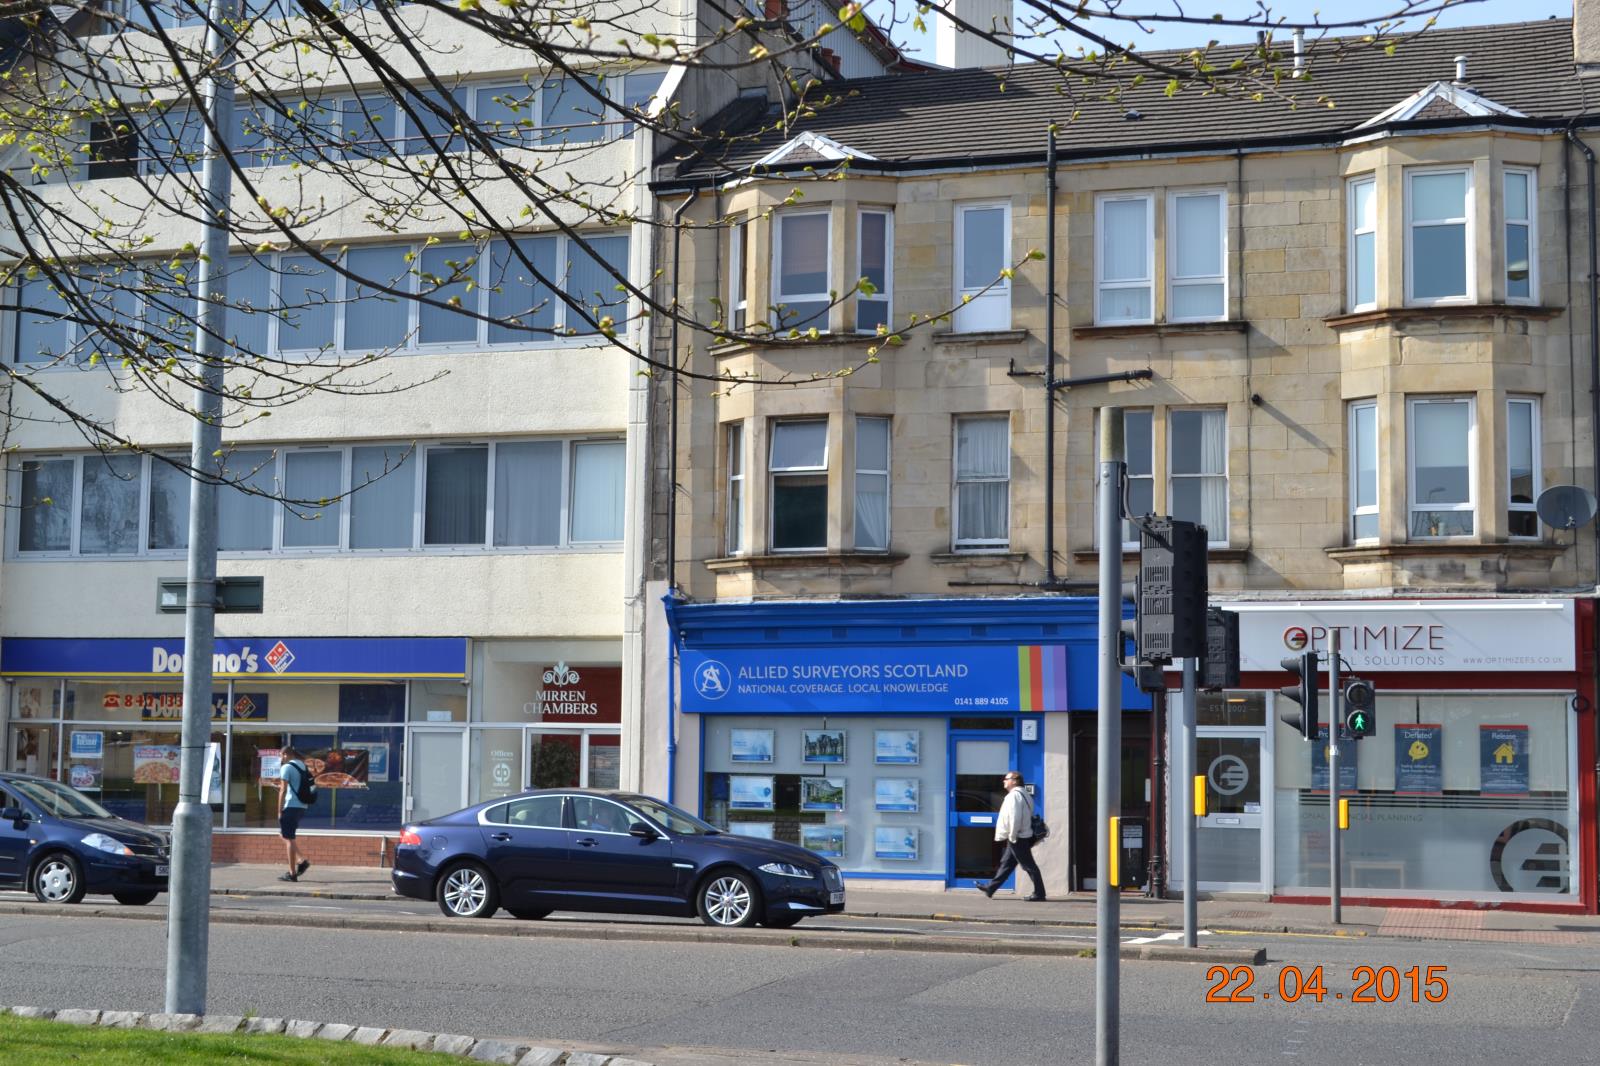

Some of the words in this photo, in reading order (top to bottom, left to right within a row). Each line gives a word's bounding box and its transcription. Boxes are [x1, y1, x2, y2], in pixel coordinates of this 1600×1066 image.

[153, 646, 259, 673] Dono's
[1364, 656, 1445, 666] SOLUTIONS
[738, 665, 789, 679] ALLIED
[792, 665, 880, 679] SURVEYORS
[884, 664, 969, 678] SCOTLAND
[738, 684, 787, 694] NATIONAL
[848, 683, 881, 693] LOCAL
[883, 683, 949, 693] KNOWLEDGE
[160, 694, 184, 708] 133
[535, 690, 586, 702] MIRREN
[954, 697, 973, 706] 0141
[974, 697, 989, 706] 889
[990, 697, 1009, 706] 4105
[523, 702, 598, 715] CHAMBERS
